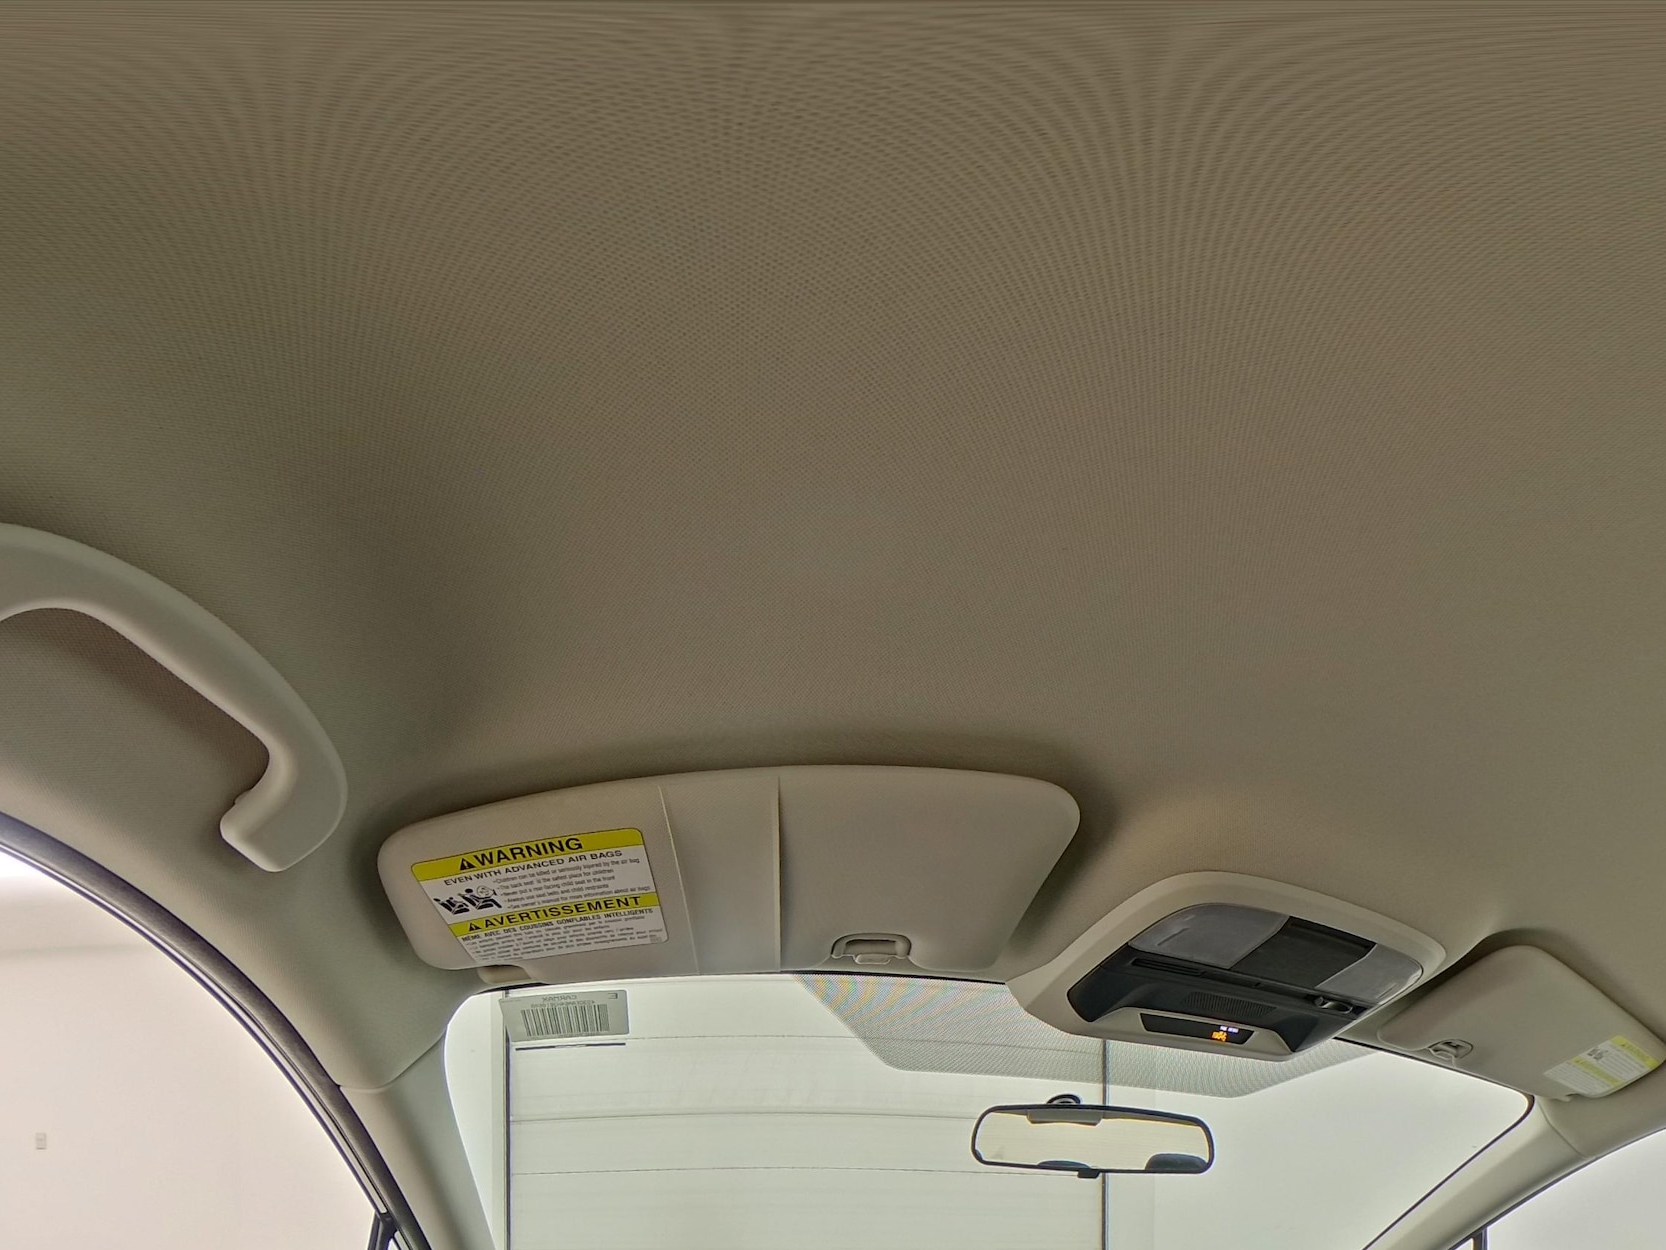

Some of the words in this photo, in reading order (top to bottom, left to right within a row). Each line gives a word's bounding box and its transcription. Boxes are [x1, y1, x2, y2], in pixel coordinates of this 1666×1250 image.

[473, 838, 583, 867] WARNING
[443, 875, 473, 886] EVEN
[474, 870, 502, 881] WITH
[505, 857, 565, 874] ADVANCED
[568, 854, 588, 863] AIR
[590, 850, 623, 860] BAGS
[484, 896, 641, 928] AVERTISSEMENT
[557, 914, 602, 925] GONFLABLES
[604, 908, 654, 918] INTELLIGENTS
